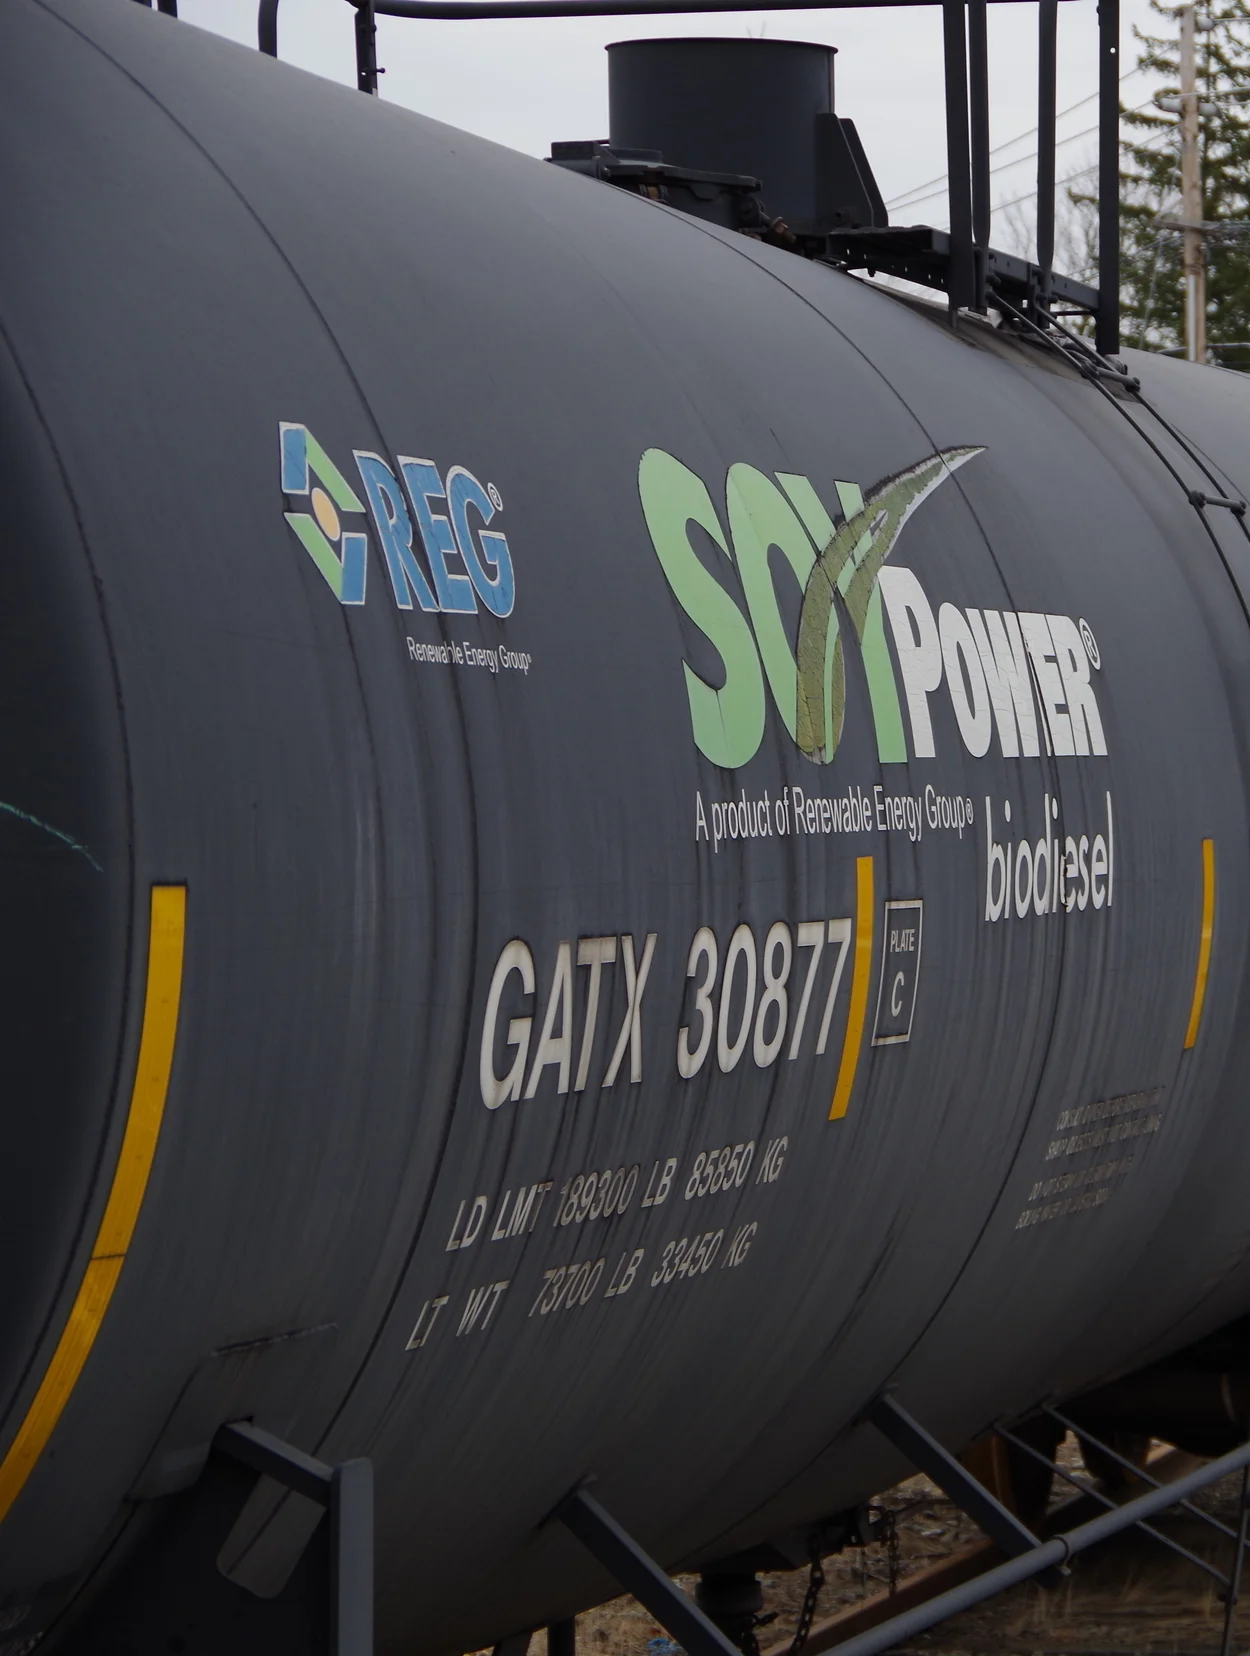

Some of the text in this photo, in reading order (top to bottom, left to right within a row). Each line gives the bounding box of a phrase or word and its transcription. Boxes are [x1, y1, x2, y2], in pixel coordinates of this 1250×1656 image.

[406, 636, 464, 665] Renewable
[463, 641, 499, 674] Energy
[695, 790, 709, 842] A
[711, 788, 773, 854] product
[775, 785, 790, 836] of
[792, 785, 873, 835] Renewable
[874, 784, 923, 842] Energy
[984, 790, 1113, 923] biodiesel
[890, 928, 916, 953] PLATE
[479, 917, 853, 1110] GATX 30877
[891, 971, 905, 1018] C
[445, 1135, 789, 1252] LD LMT 189300 LB 85850 KG
[404, 1220, 758, 1352] LT WT 73700 LB 33450 KG
